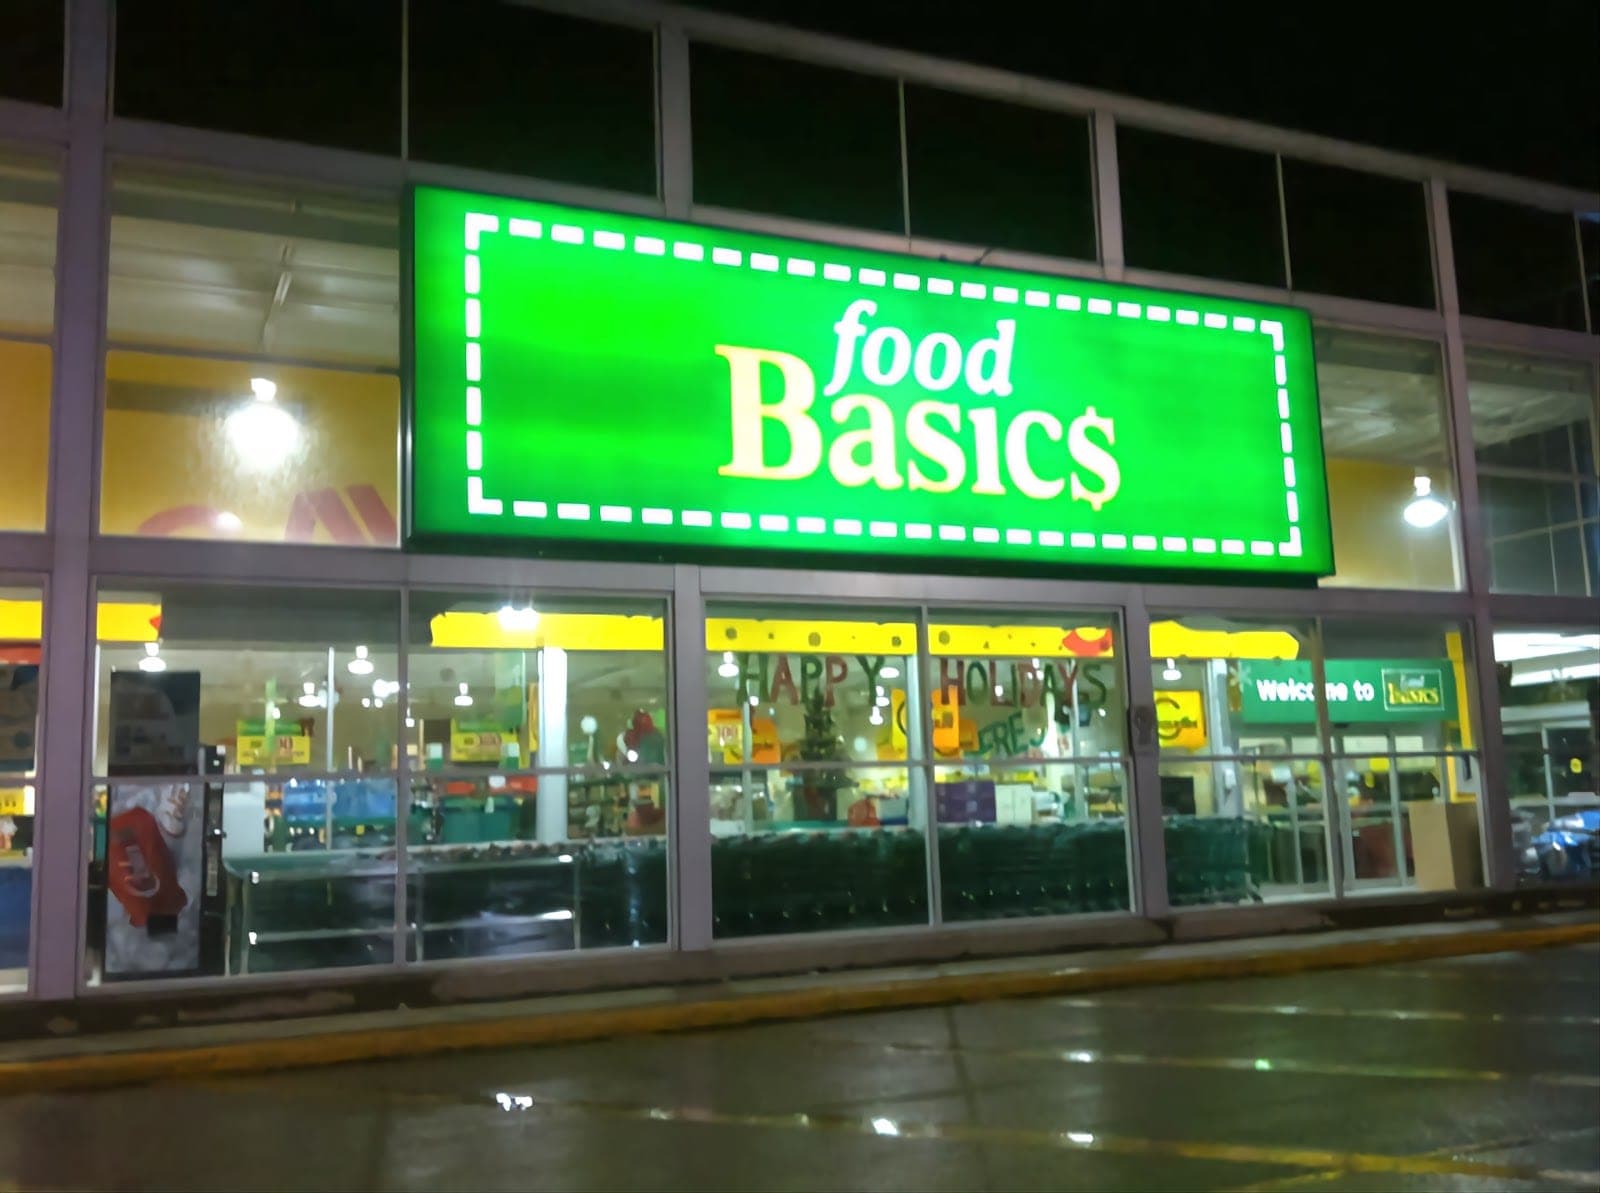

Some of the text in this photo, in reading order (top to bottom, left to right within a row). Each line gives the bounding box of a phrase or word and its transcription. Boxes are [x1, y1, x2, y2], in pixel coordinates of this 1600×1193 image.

[823, 299, 1016, 397] food
[736, 652, 1107, 709] HAPPY HOLIDAYS
[1353, 680, 1375, 701] to
